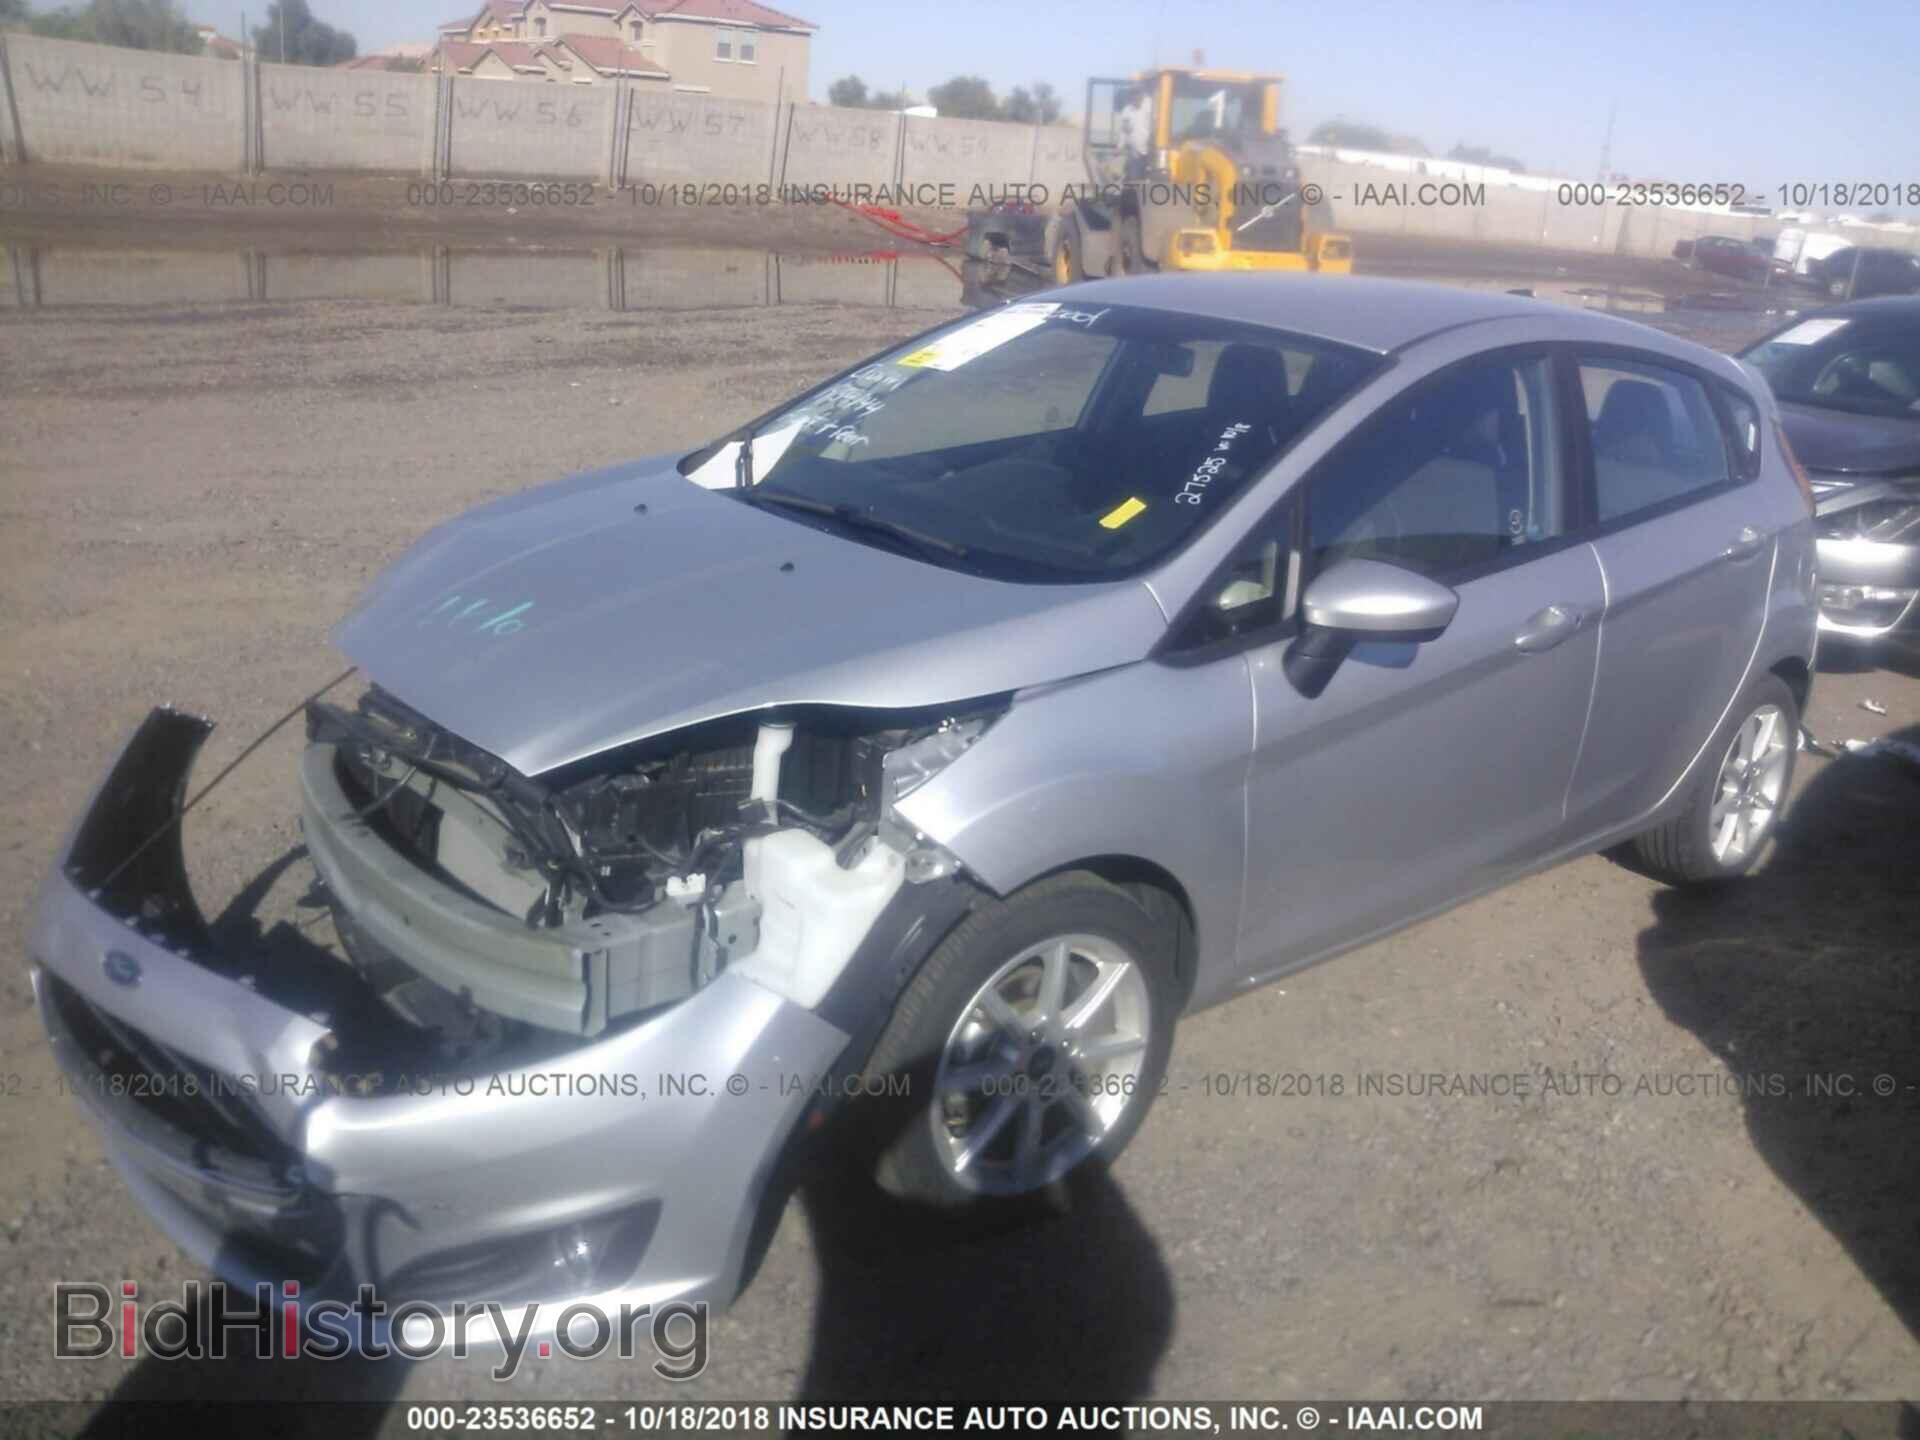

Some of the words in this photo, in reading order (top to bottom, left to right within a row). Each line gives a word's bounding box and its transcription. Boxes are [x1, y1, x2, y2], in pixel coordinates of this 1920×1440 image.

[25, 62, 118, 97] WW
[140, 75, 203, 107] 54
[457, 96, 521, 121] WW
[1174, 456, 1227, 505] 27525
